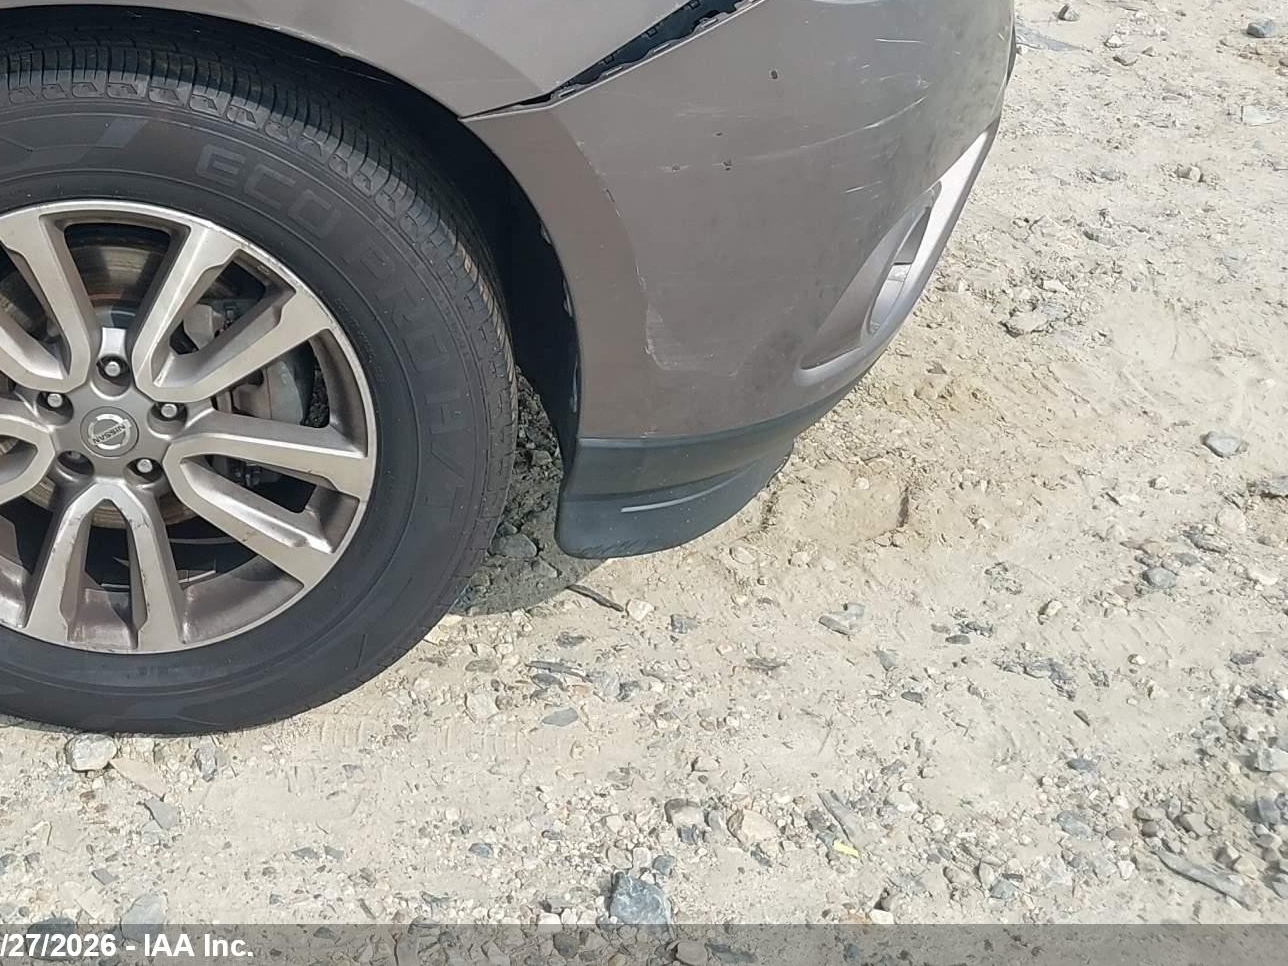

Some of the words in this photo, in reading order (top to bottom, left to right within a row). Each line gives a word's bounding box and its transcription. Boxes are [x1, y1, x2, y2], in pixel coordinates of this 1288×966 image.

[196, 144, 343, 240] ECO
[342, 234, 450, 374] PRO
[92, 423, 126, 444] NISSAN
